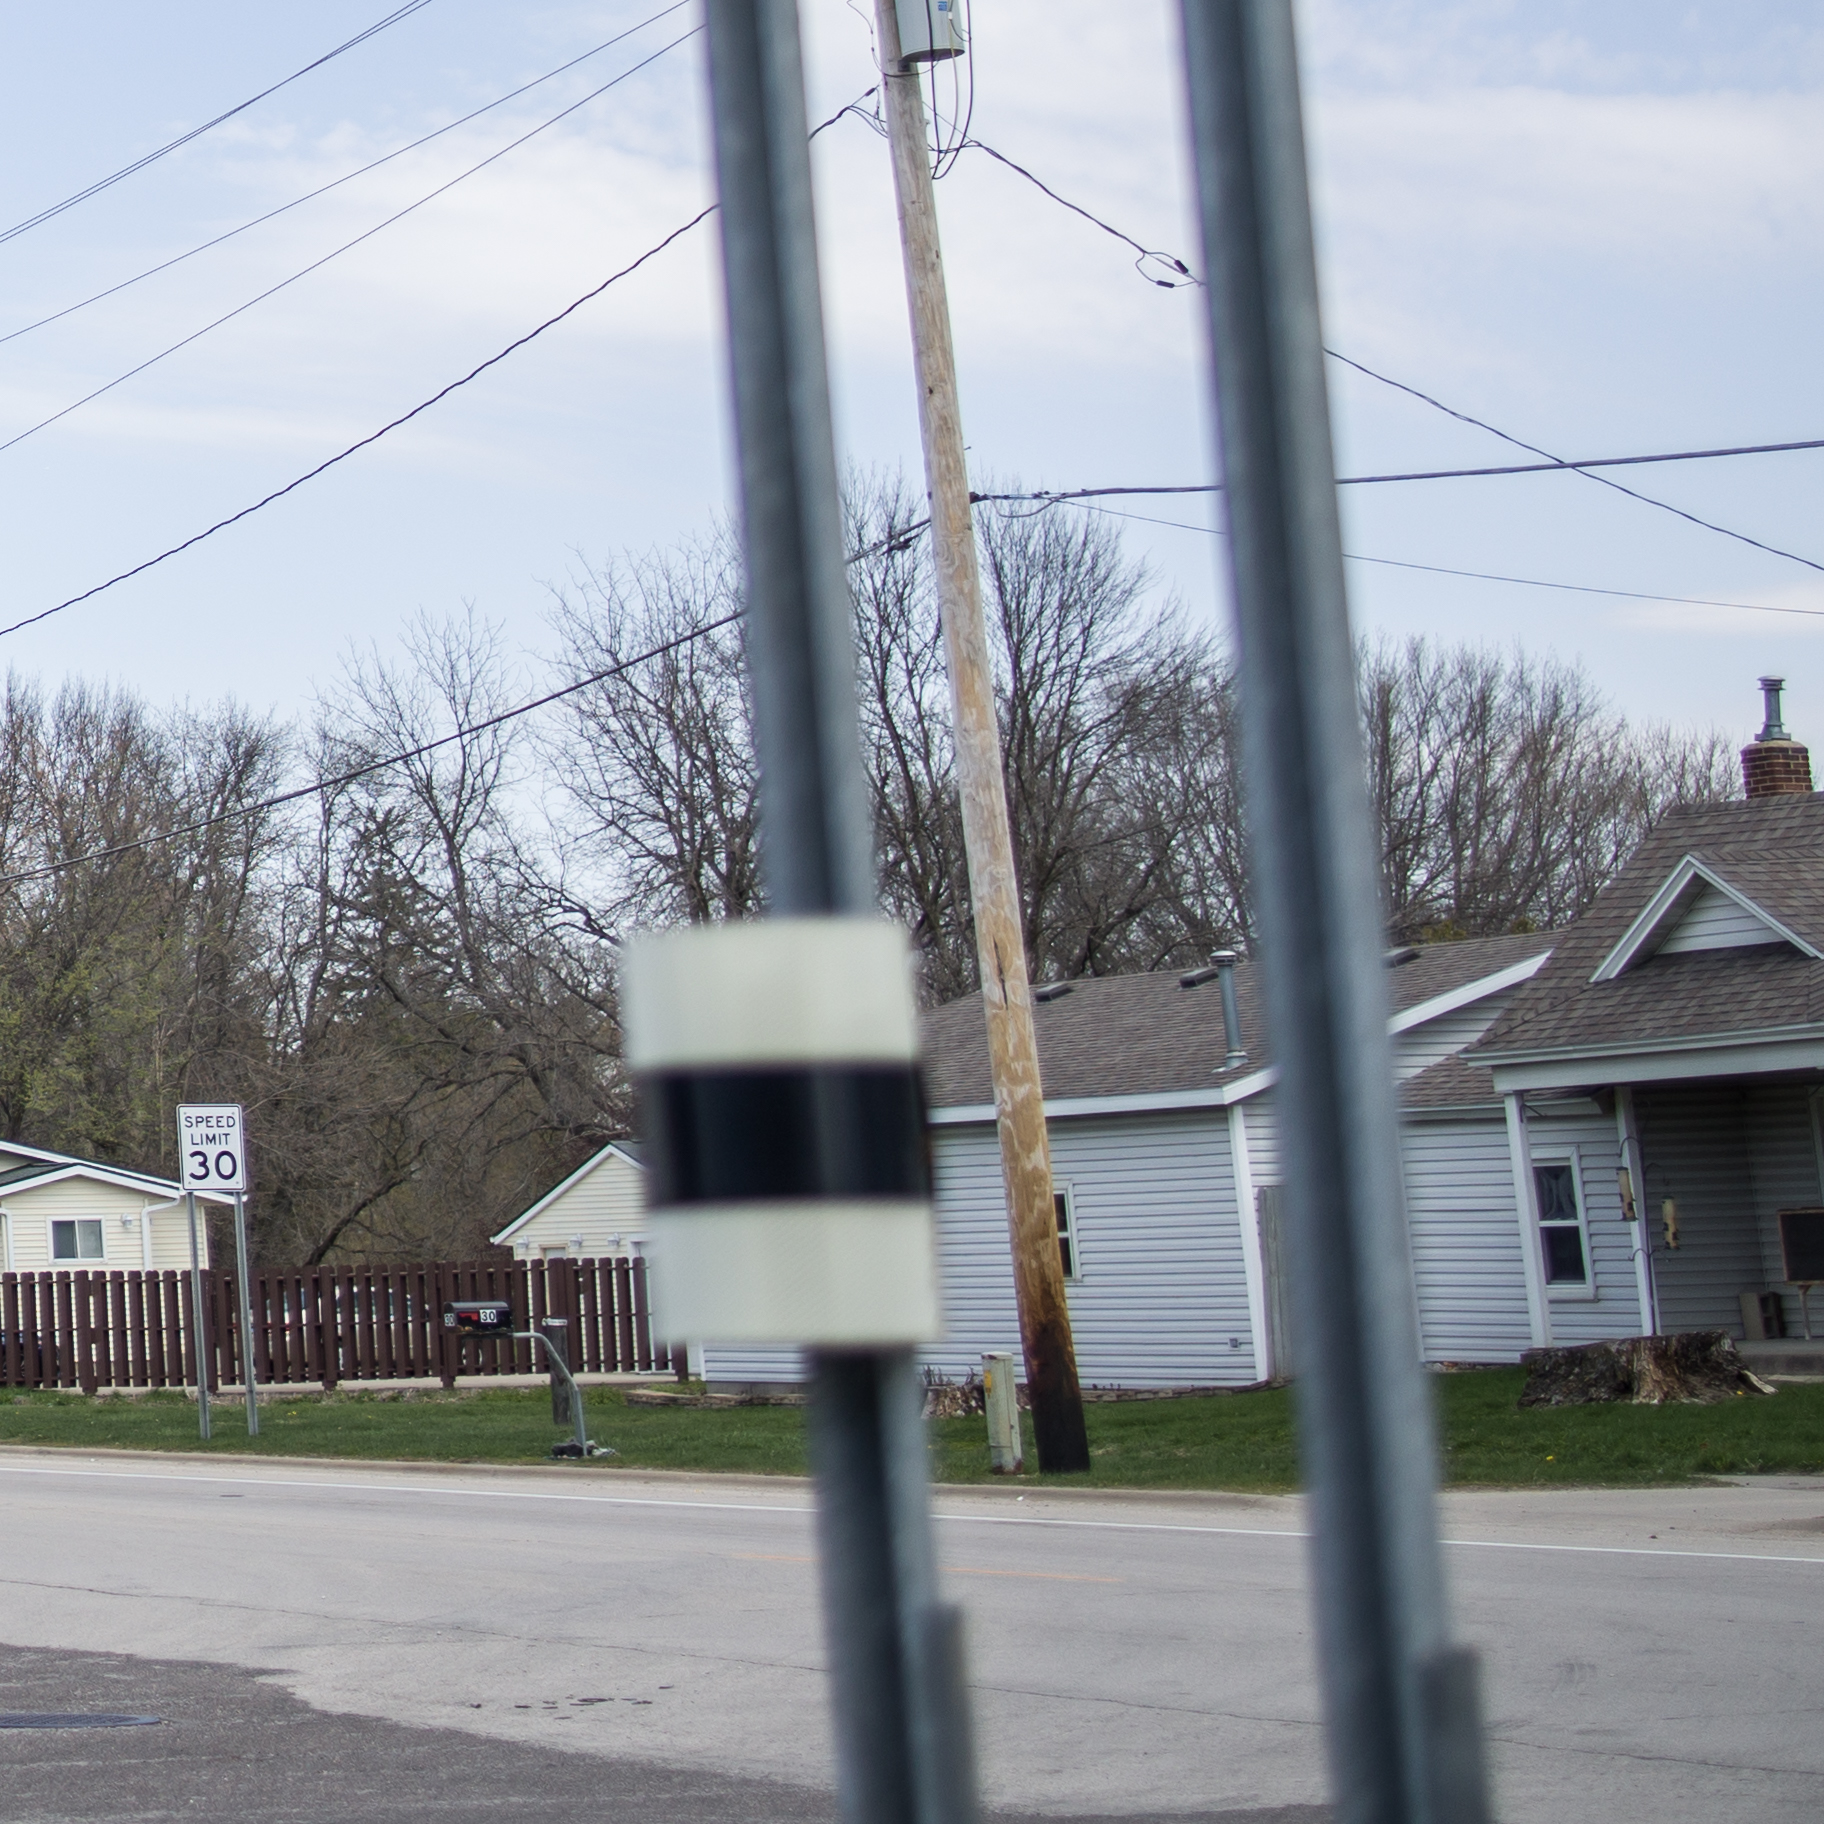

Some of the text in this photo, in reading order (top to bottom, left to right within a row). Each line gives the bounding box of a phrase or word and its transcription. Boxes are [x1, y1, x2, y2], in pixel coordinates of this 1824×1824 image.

[184, 1115, 236, 1128] SPEED
[190, 1133, 231, 1146] LIMIT
[188, 1150, 238, 1181] 30
[481, 1310, 496, 1322] 30
